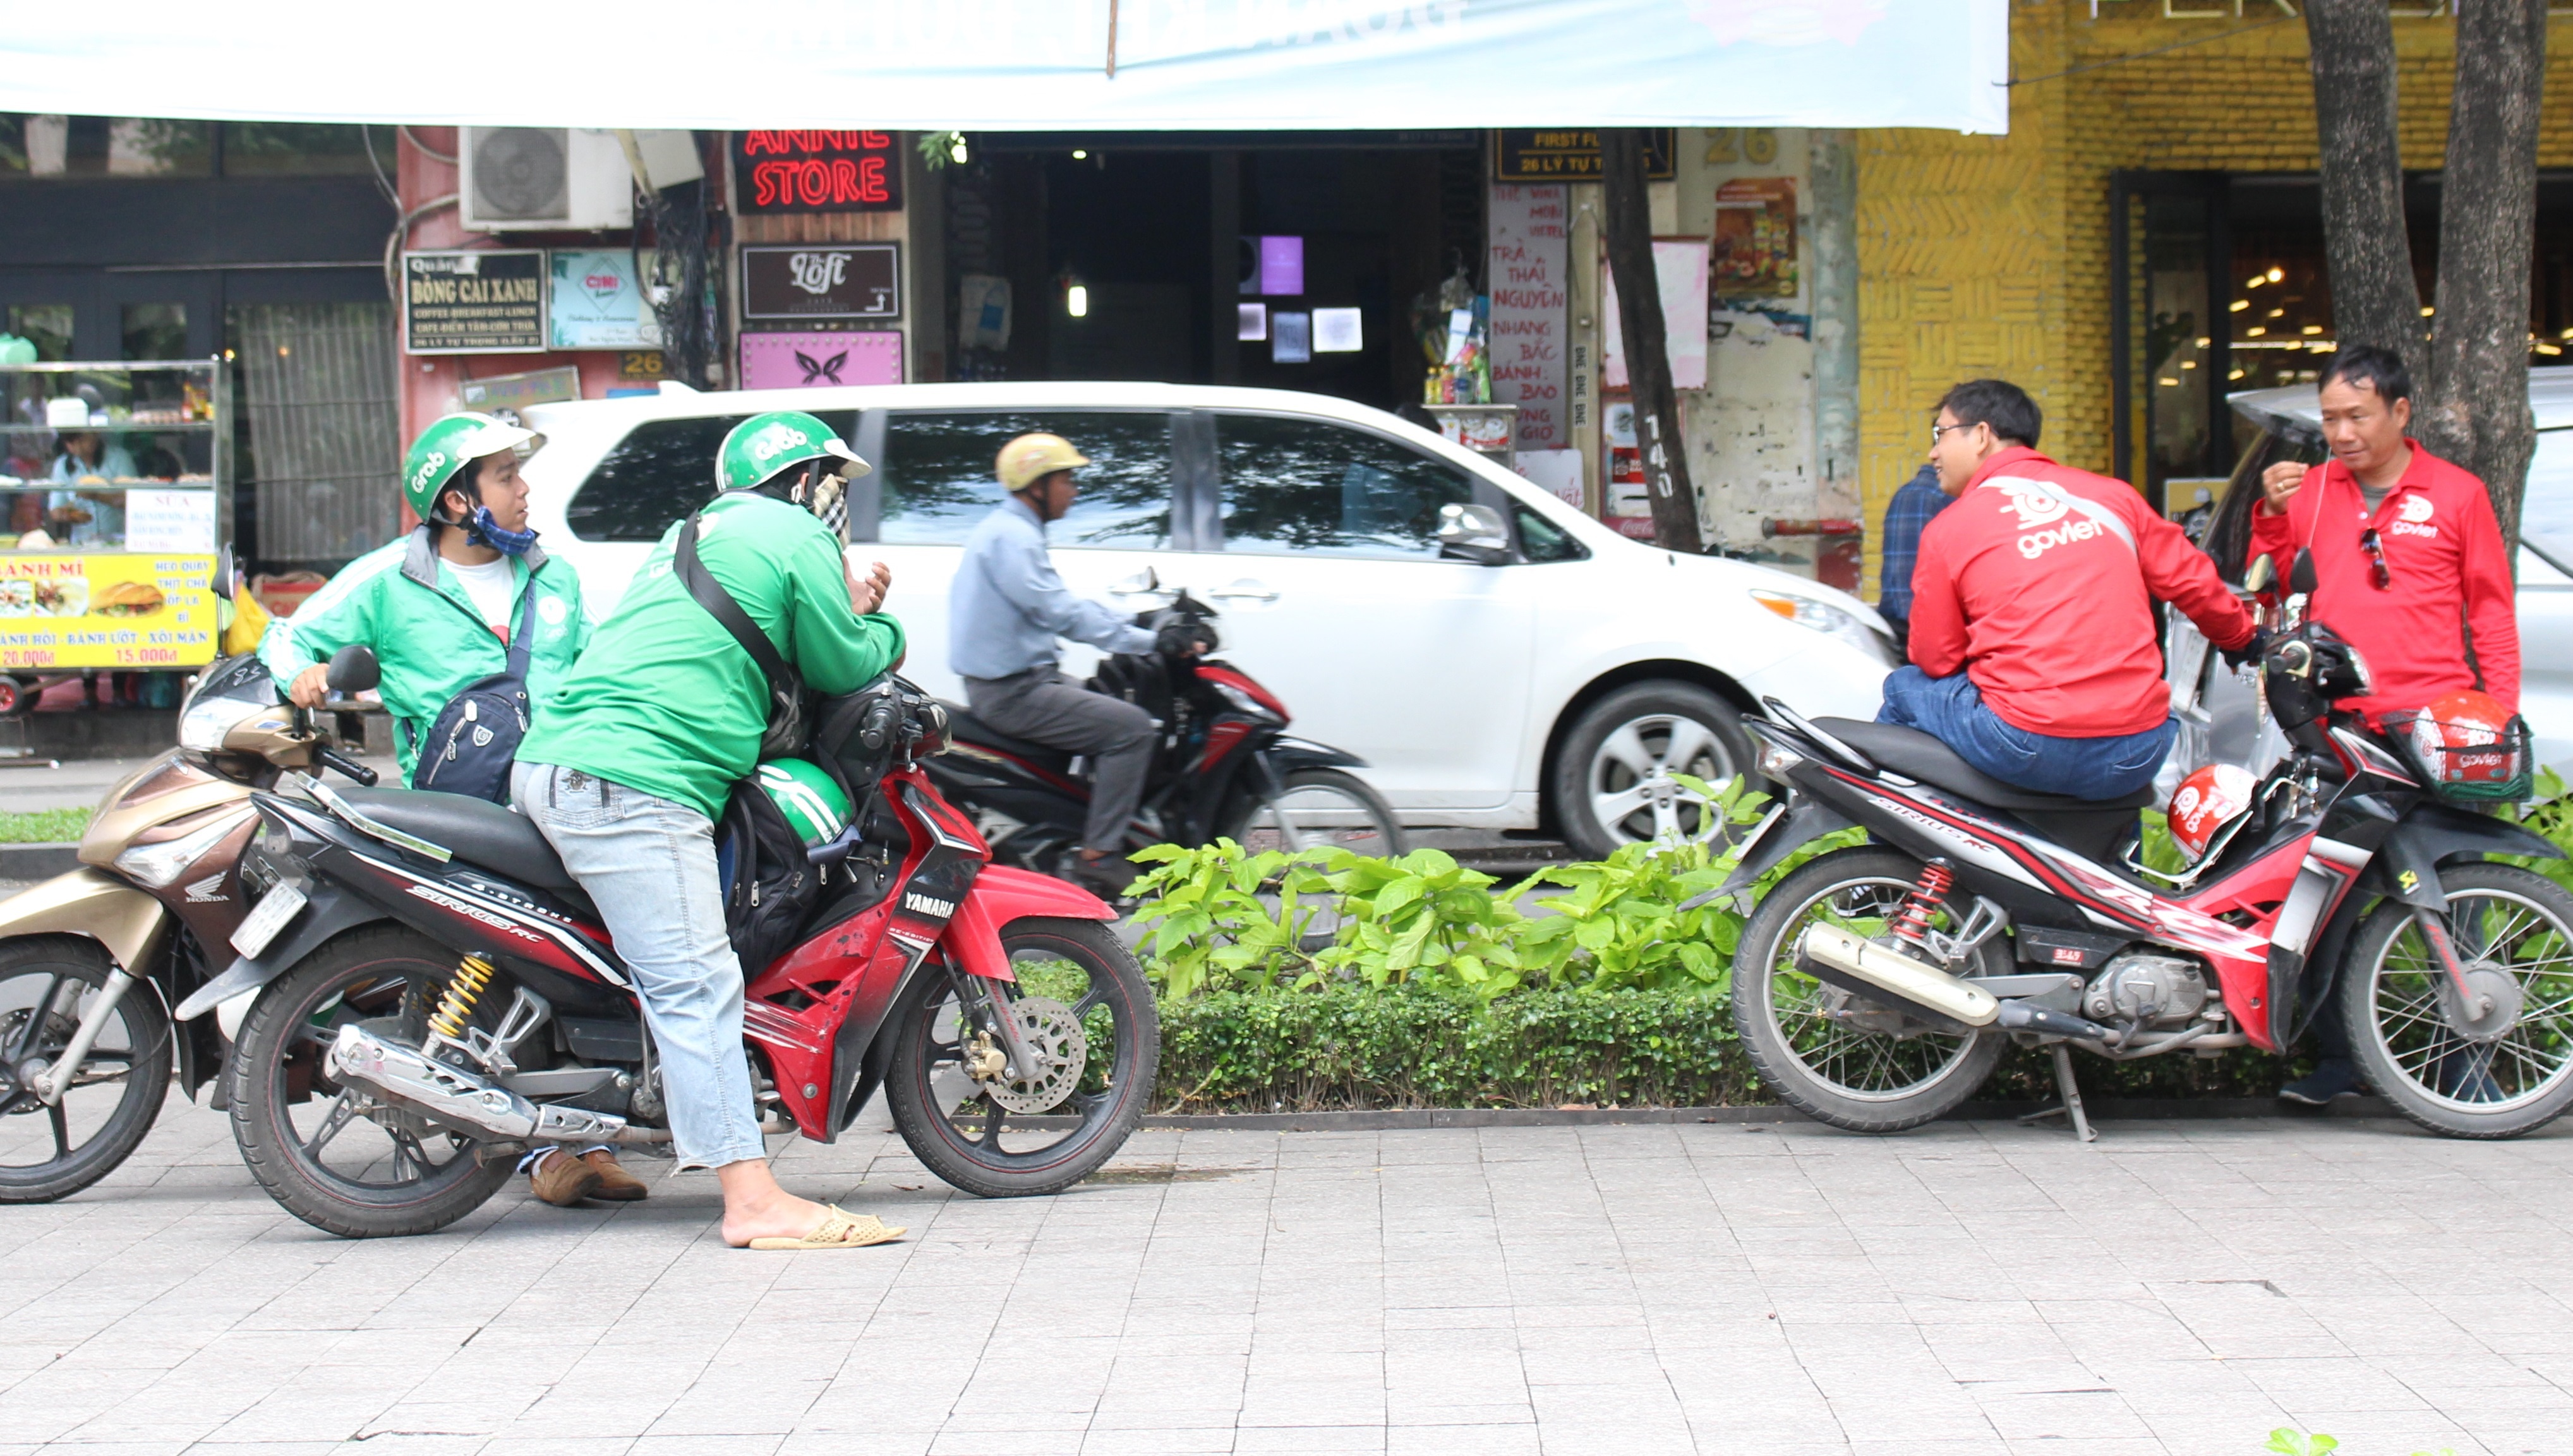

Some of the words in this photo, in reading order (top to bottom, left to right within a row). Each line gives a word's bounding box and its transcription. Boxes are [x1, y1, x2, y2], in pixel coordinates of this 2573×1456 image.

[744, 129, 890, 155] ANNIE
[1534, 132, 1579, 147] FIRST
[1706, 127, 1778, 164] 26
[1521, 157, 1540, 172] 26
[752, 157, 889, 207] STORE
[490, 277, 538, 302] XANH
[624, 352, 663, 373] 26
[411, 451, 446, 493] Grab
[2017, 517, 2104, 560] goviet
[2392, 521, 2439, 539] goviet
[186, 894, 230, 903] HONDA
[905, 891, 955, 919] YAMAHA
[405, 884, 519, 930] SIRIUS
[509, 927, 545, 943] RC
